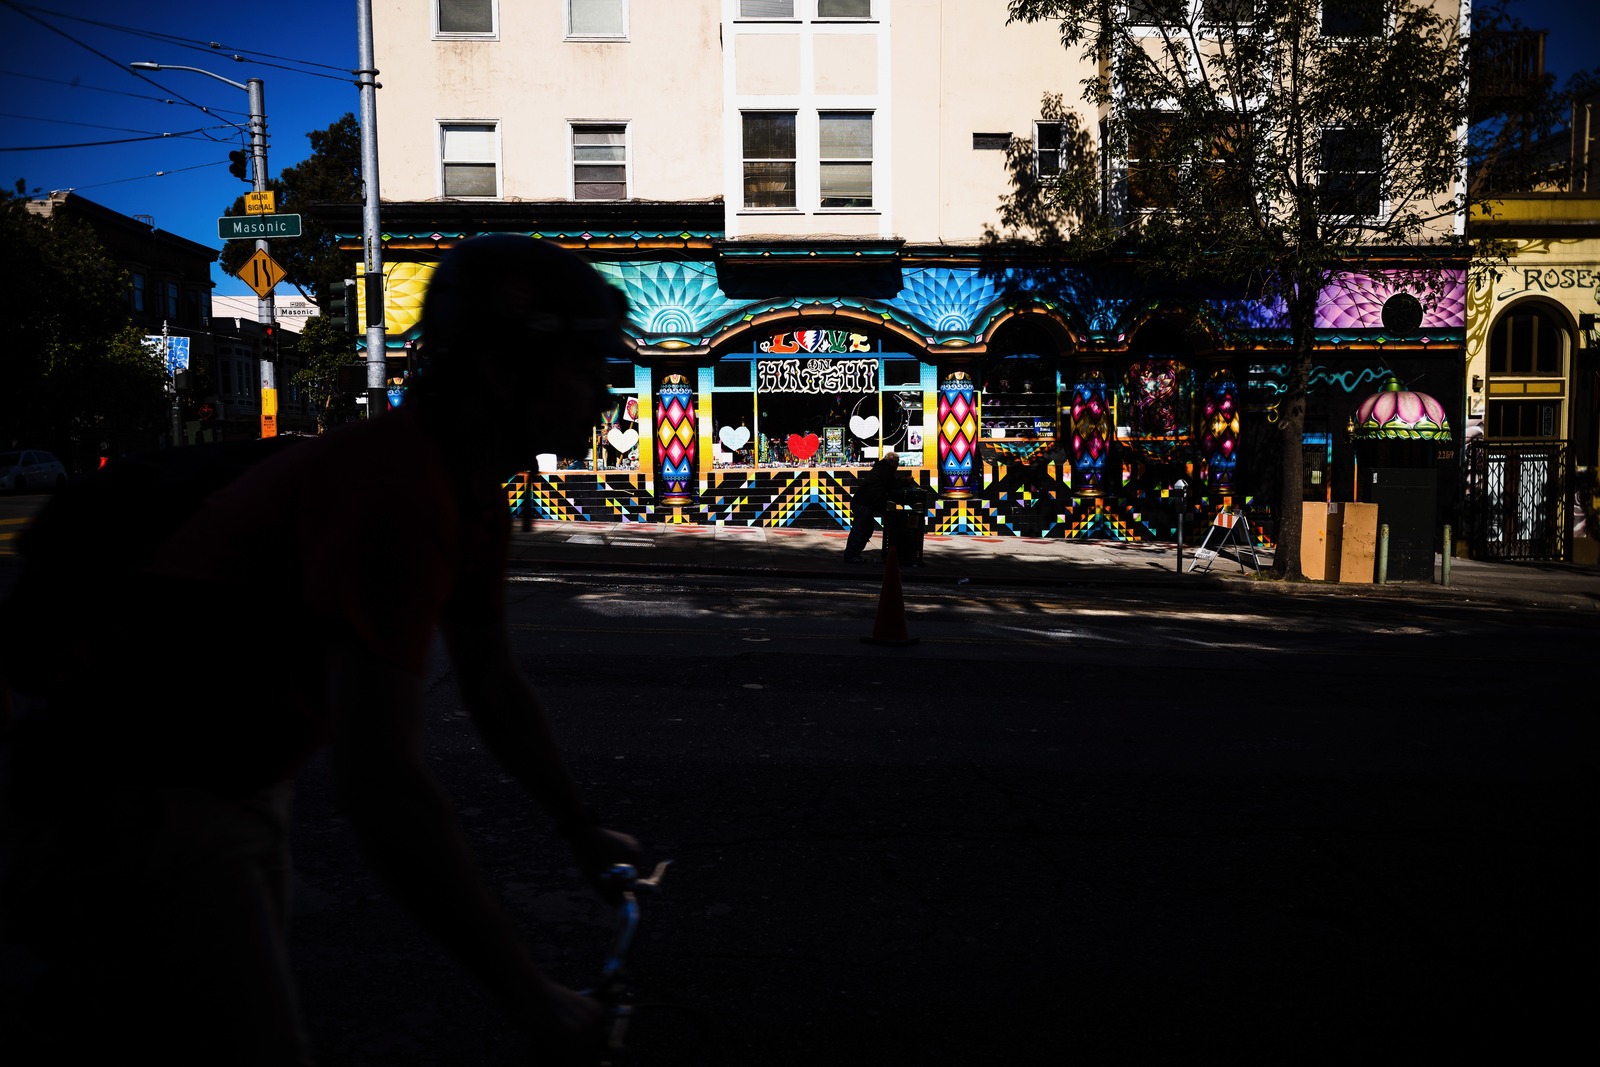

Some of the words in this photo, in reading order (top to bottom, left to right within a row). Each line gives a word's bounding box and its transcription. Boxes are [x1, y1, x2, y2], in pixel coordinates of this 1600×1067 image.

[247, 203, 273, 211] SIGNAL
[233, 221, 287, 233] Masonic
[807, 359, 832, 371] ON
[757, 359, 879, 394] HAIGHT
